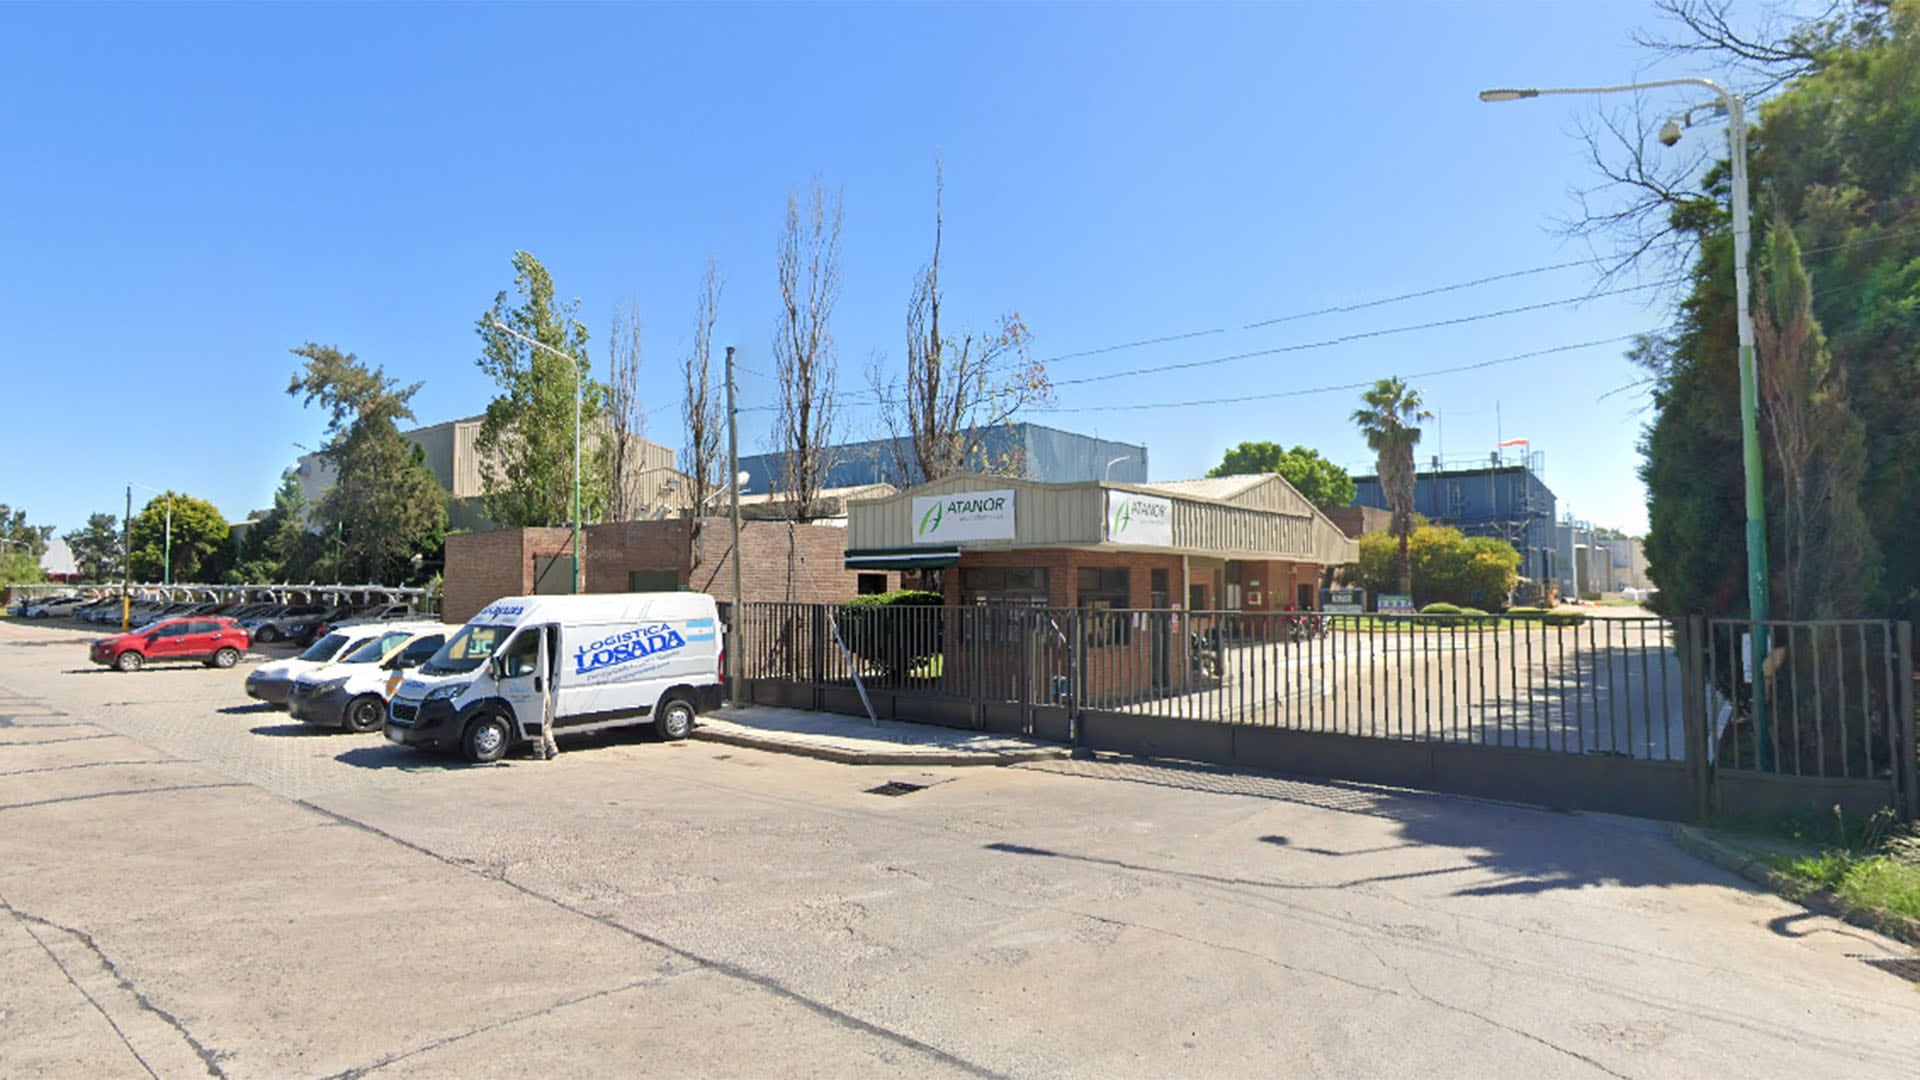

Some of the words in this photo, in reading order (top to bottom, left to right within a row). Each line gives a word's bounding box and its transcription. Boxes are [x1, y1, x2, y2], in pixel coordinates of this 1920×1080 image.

[947, 497, 1005, 514] ATANOR
[1131, 501, 1168, 518] ATANOR
[578, 623, 672, 654] LOGISTICA
[573, 630, 686, 674] LOSADA
